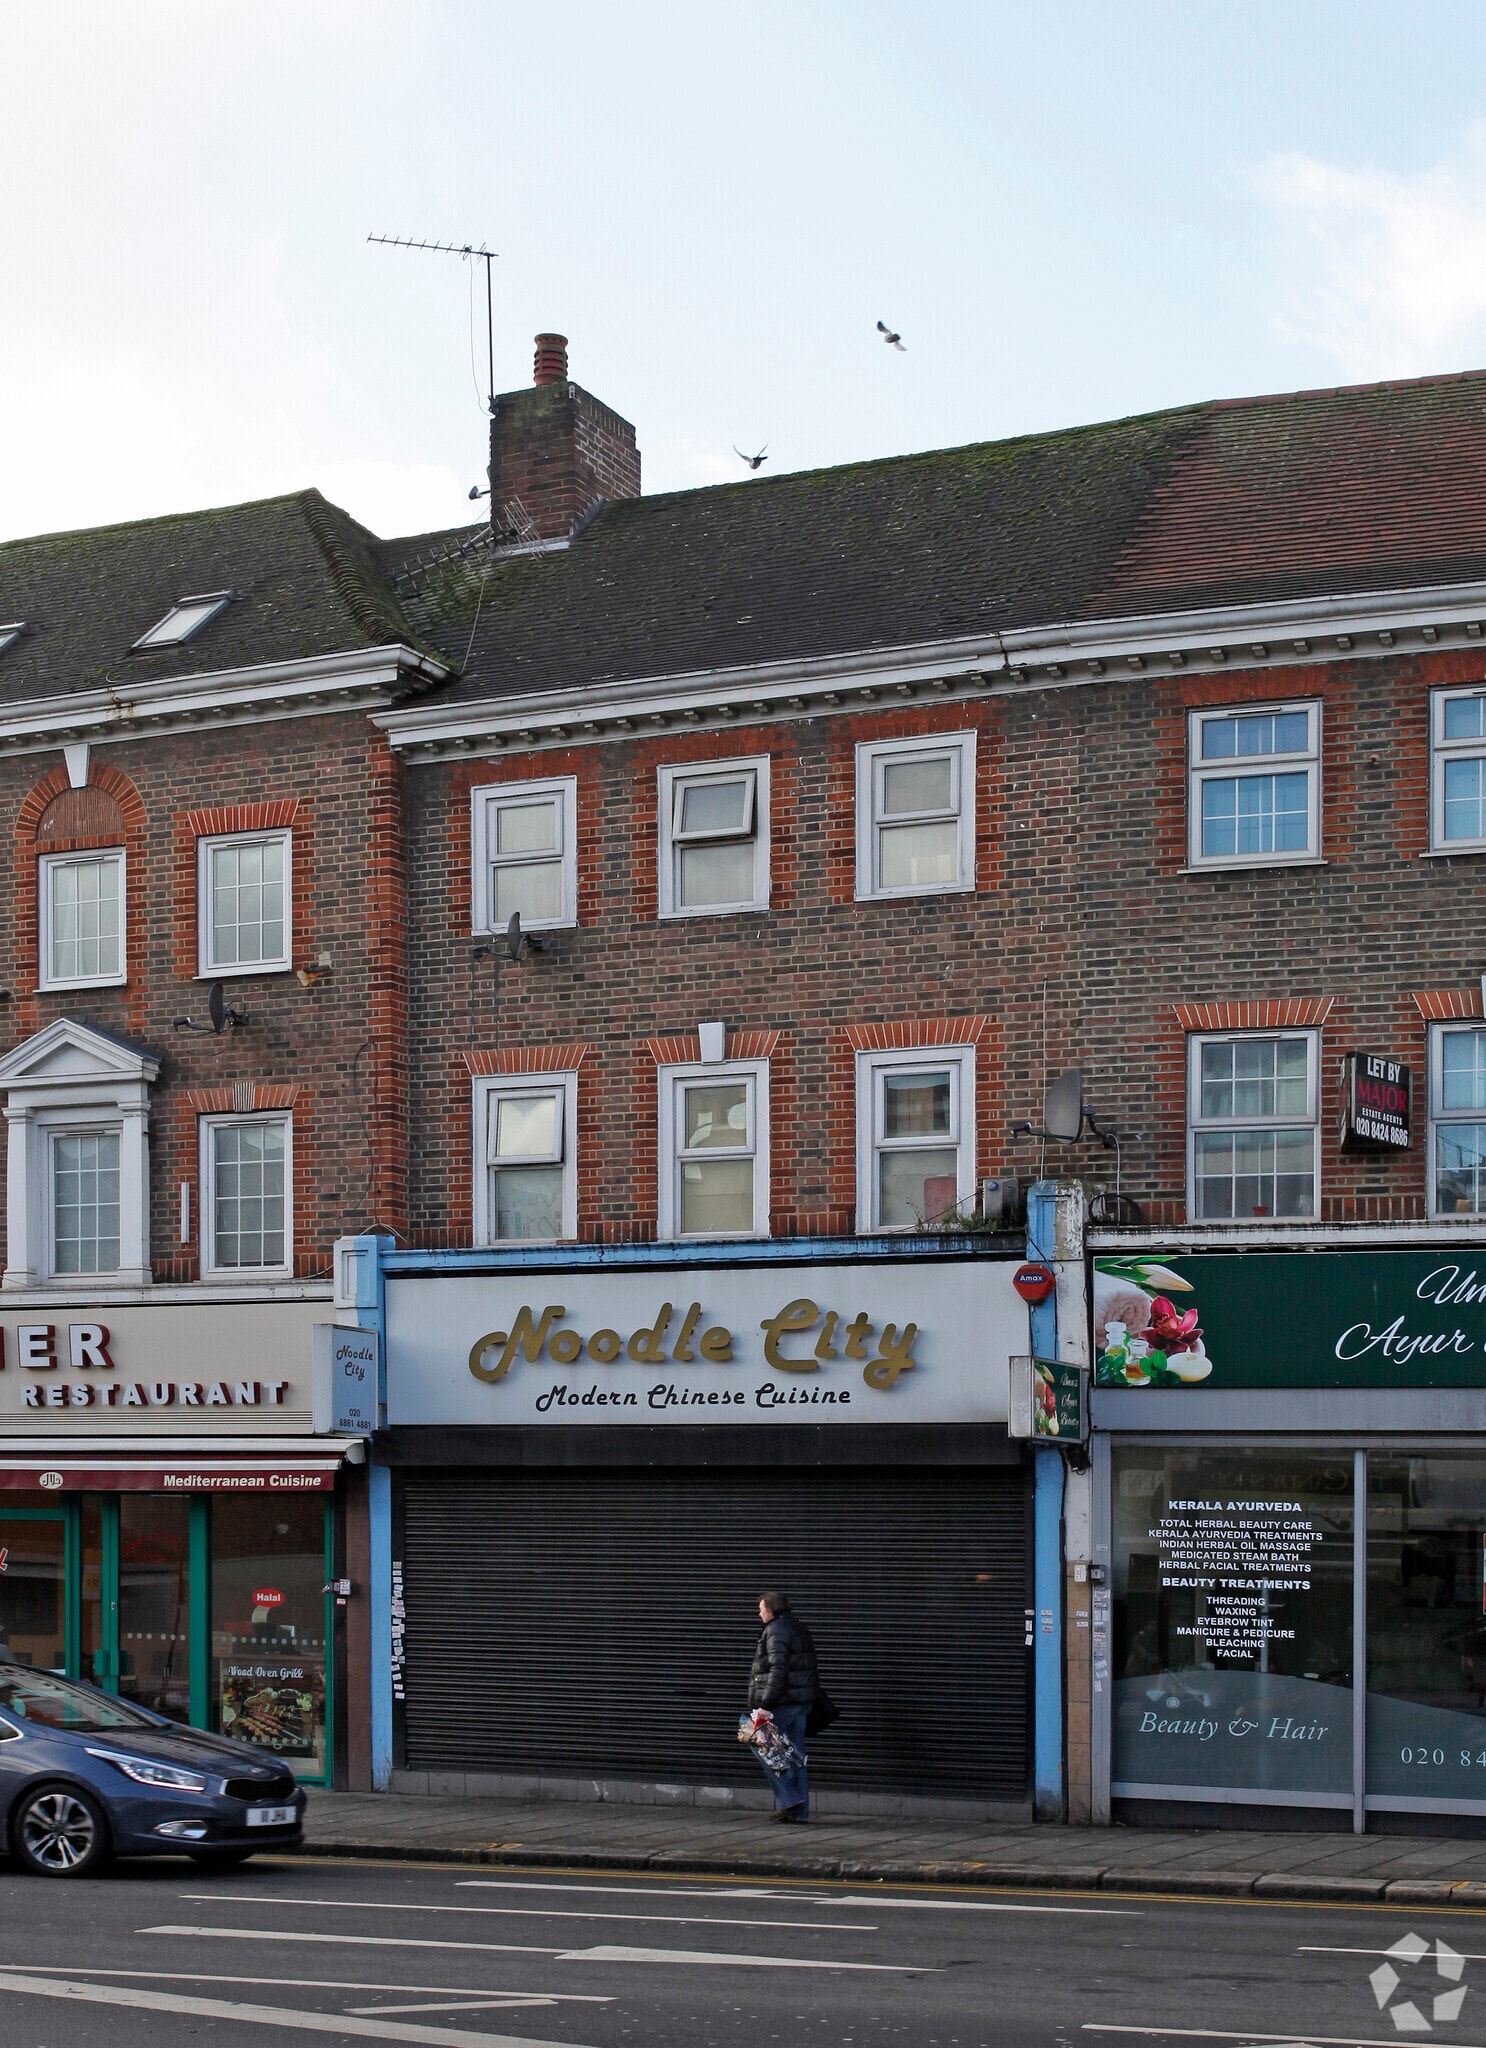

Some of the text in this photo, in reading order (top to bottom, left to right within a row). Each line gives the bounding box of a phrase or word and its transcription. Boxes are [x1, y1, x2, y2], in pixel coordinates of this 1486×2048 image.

[1367, 1057, 1400, 1083] LET BY
[1357, 1078, 1407, 1114] MAJOR
[1362, 1107, 1403, 1126] ESTATE AGENTS
[1356, 1117, 1370, 1137] 020
[1371, 1121, 1389, 1142] 8424
[0, 1323, 115, 1369] ER
[468, 1298, 920, 1389] Noodle City
[1335, 1315, 1475, 1365] Ayur
[336, 1345, 374, 1360] Noodle
[344, 1361, 366, 1381] City
[20, 1381, 289, 1409] RESTAURANT
[535, 1382, 851, 1412] Modern Chinese Cuisine
[349, 1408, 361, 1417] 020
[163, 1474, 321, 1487] Mediterranean Cuisine
[1168, 1500, 1223, 1510] KERALA
[1226, 1501, 1302, 1512] AYURVEDA
[1159, 1519, 1312, 1530] TOTAL HERBAL BEAUTY CARE
[1148, 1530, 1323, 1541] KERALA AYURVEDIA TREATMENTS
[1159, 1540, 1311, 1551] INDIAN HERBAL OIL MASSAGE
[1171, 1551, 1299, 1561] MEDICATED STEAM BATH
[1159, 1561, 1311, 1572] HERBAL FACIAL TREATMENTS
[1162, 1577, 1311, 1590] BEAUTY TREATMENTS
[256, 1593, 281, 1602] Halal
[1206, 1596, 1266, 1606] THREADING
[1215, 1607, 1257, 1616] WAXING
[1197, 1617, 1274, 1627] EYEBROW TINT
[1176, 1627, 1295, 1638] MANICURE & PEDICURE
[1205, 1638, 1265, 1648] BLEACHING
[1217, 1649, 1254, 1658] FACIAL
[228, 1666, 304, 1680] Wood Oven Grill
[1138, 1711, 1329, 1741] Beauty & Hair
[1401, 1747, 1445, 1766] 020
